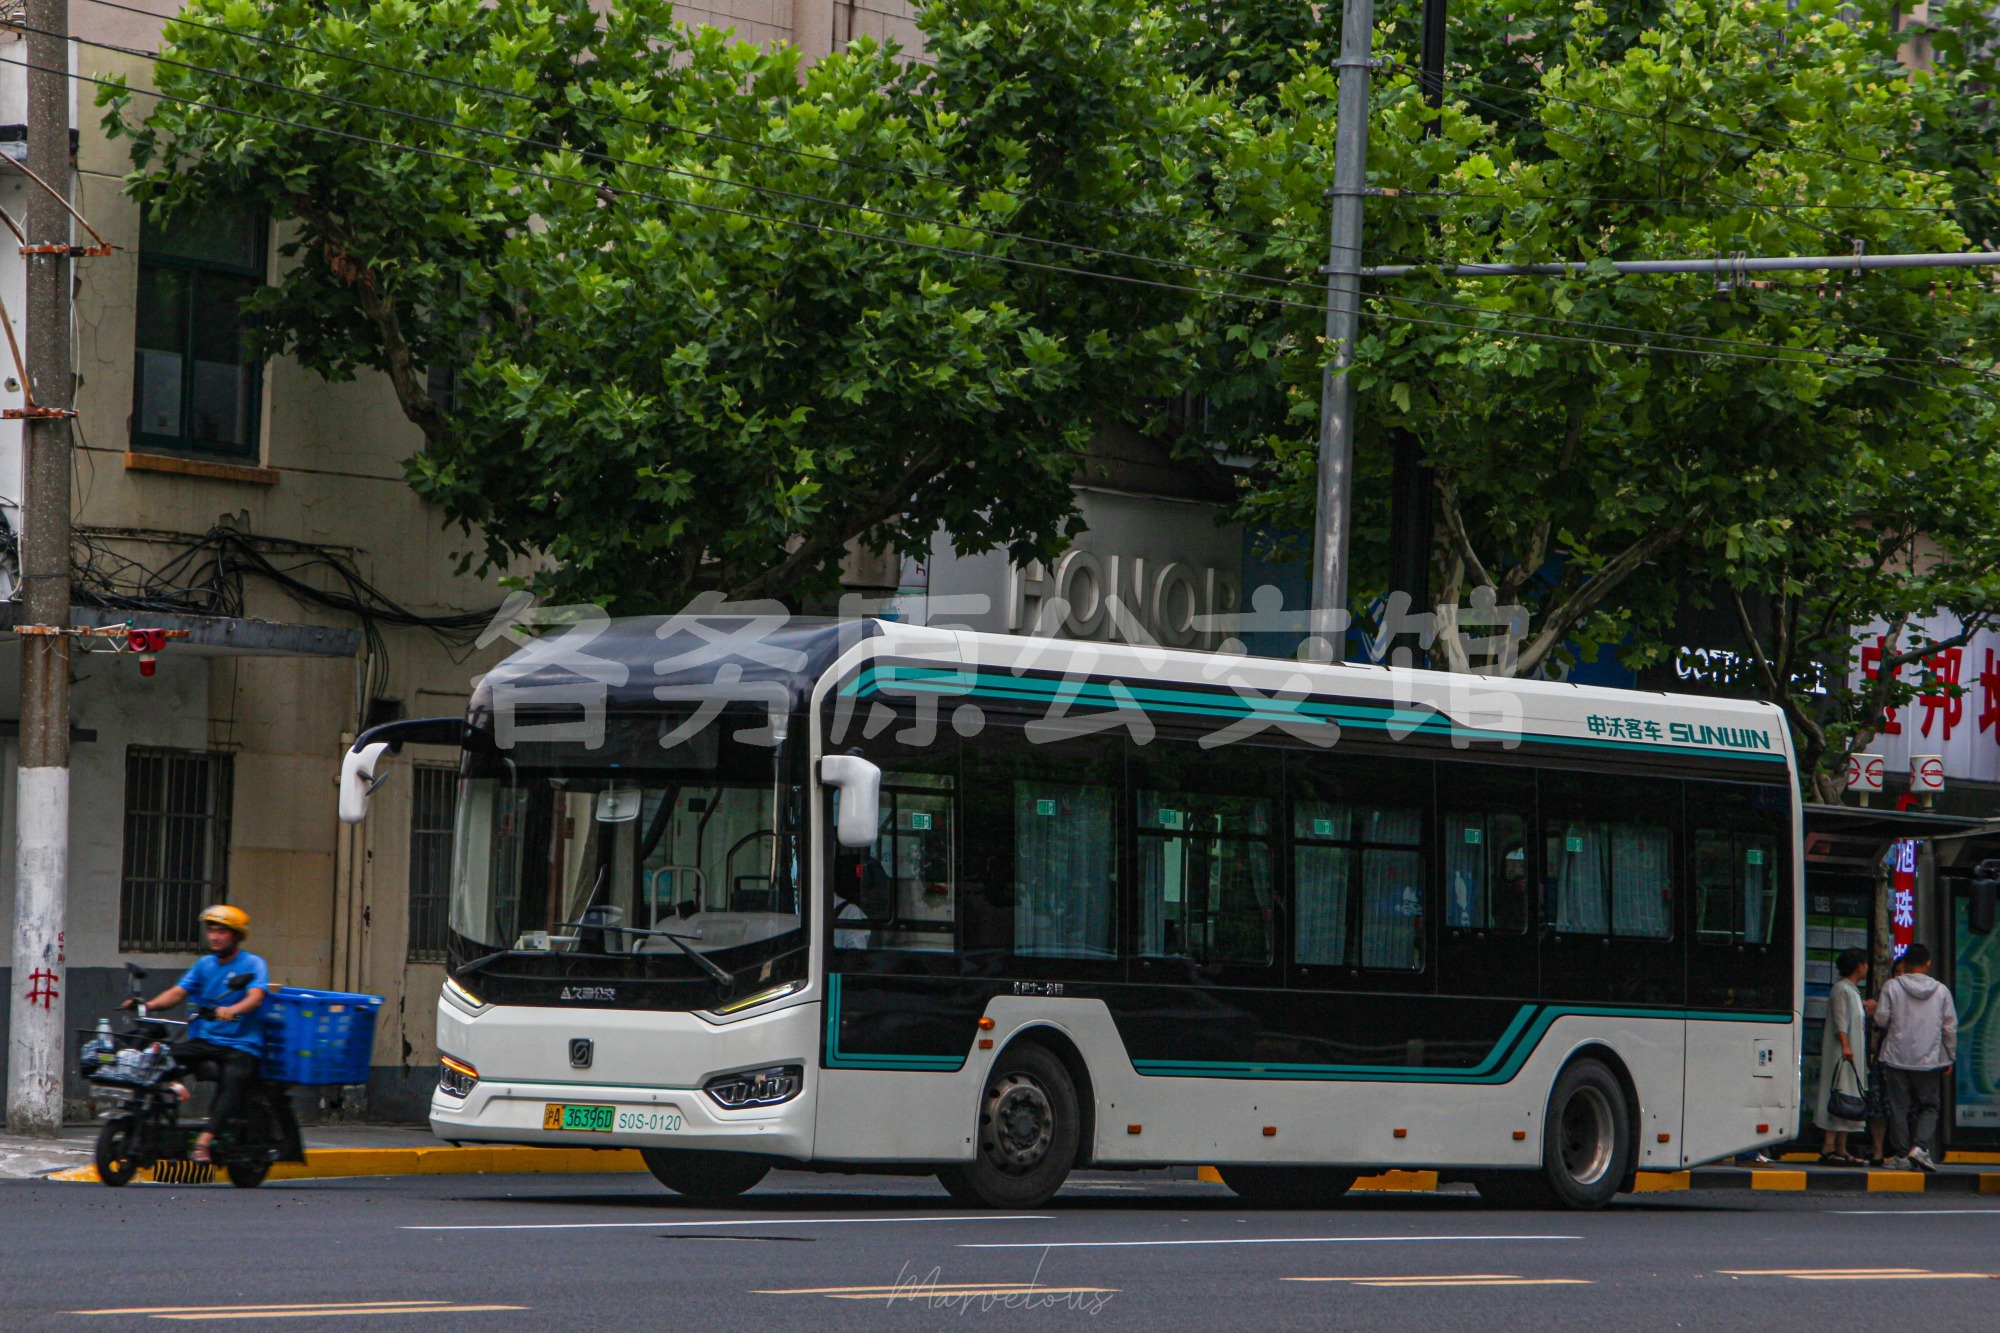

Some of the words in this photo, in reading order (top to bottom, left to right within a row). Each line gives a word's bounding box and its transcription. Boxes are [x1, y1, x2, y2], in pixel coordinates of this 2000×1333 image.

[1009, 550, 1241, 651] HONOR
[1587, 714, 1663, 741] 申沃客车
[1669, 722, 1771, 749] SUNWIN
